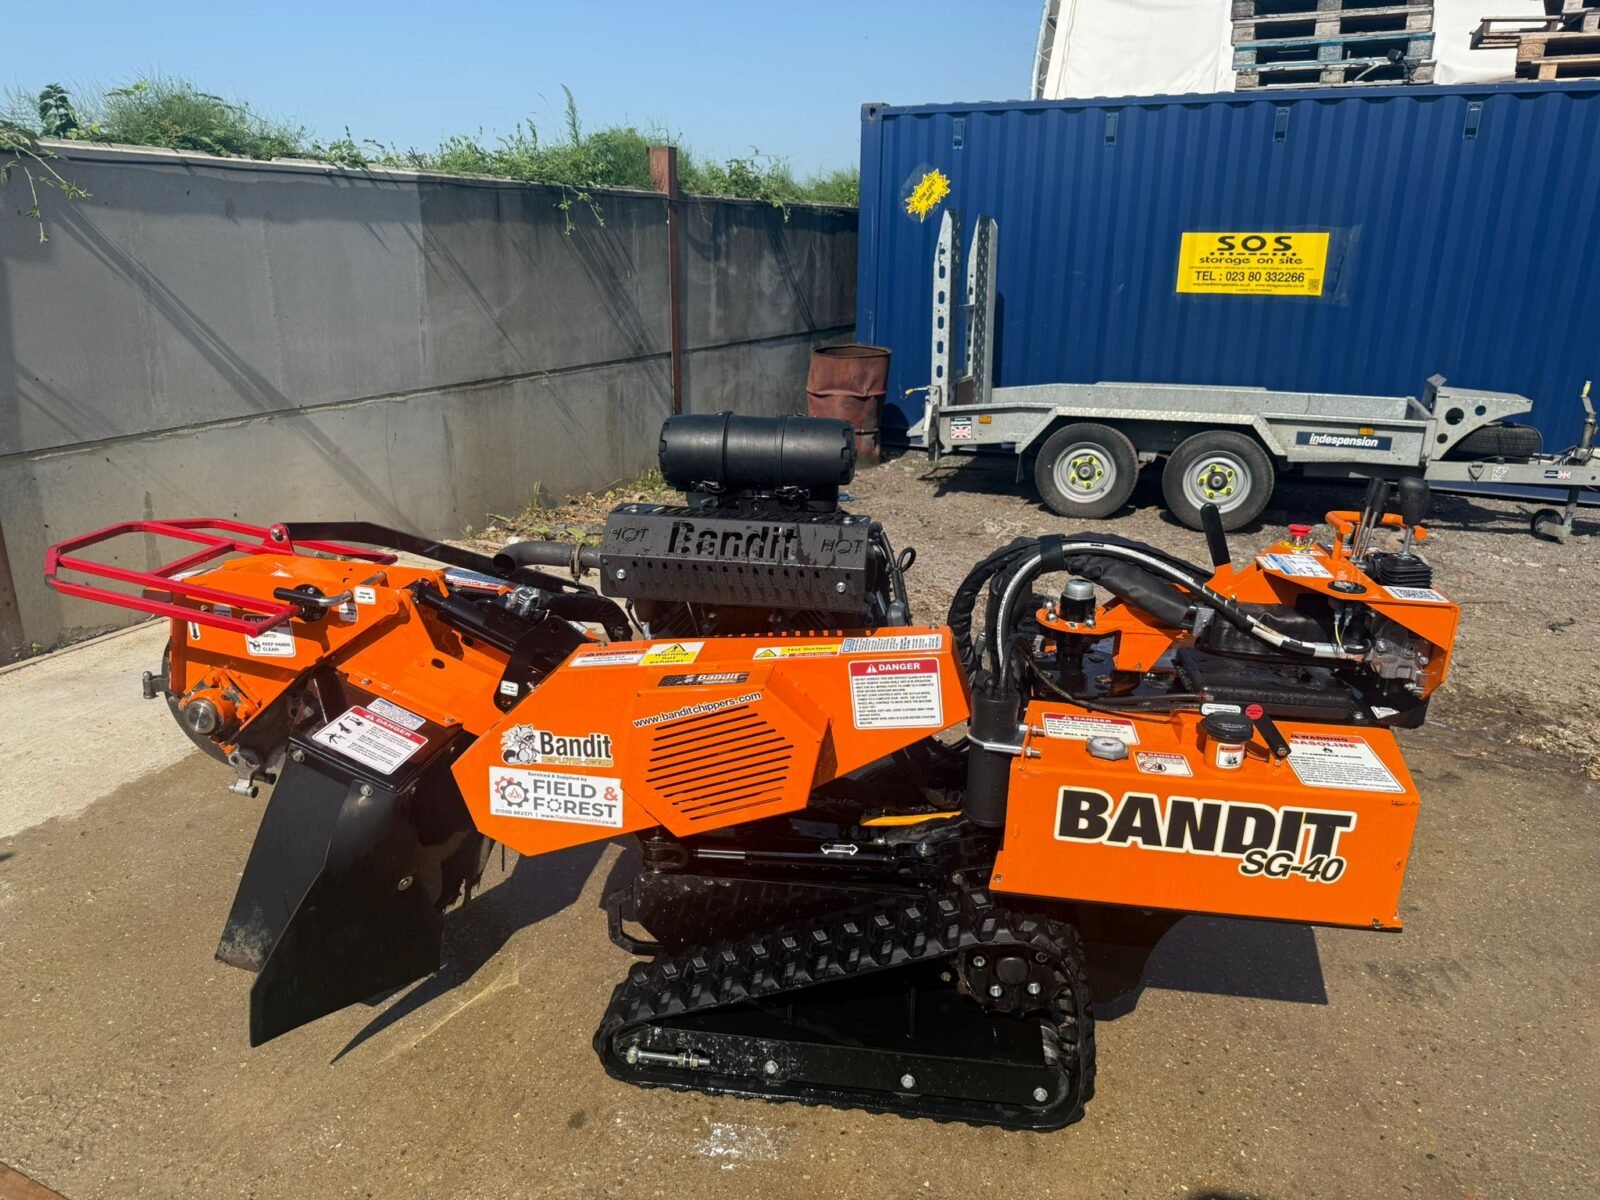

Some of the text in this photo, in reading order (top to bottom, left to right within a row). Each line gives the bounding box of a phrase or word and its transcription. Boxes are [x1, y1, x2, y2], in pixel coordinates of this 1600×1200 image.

[1216, 235, 1292, 252] SOS
[1199, 256, 1303, 266] storage on site
[1194, 270, 1216, 281] TEL
[1226, 271, 1245, 282] 023
[1248, 271, 1262, 282] 80
[1264, 271, 1305, 283] 332266
[612, 527, 649, 543] HOT
[668, 521, 798, 561] Bandit
[821, 538, 864, 554] HOT
[878, 662, 921, 672] DANGER
[698, 672, 740, 681] Bandit
[633, 691, 761, 727] www.banditchippers.com
[375, 717, 413, 737] DANGER
[540, 731, 612, 759] Bandit
[1290, 740, 1358, 748] GASOLINE
[533, 779, 618, 801] FIELD &
[533, 796, 617, 818] FOREST
[1057, 788, 1353, 860] BANDIT
[1239, 849, 1345, 883] SG-40
